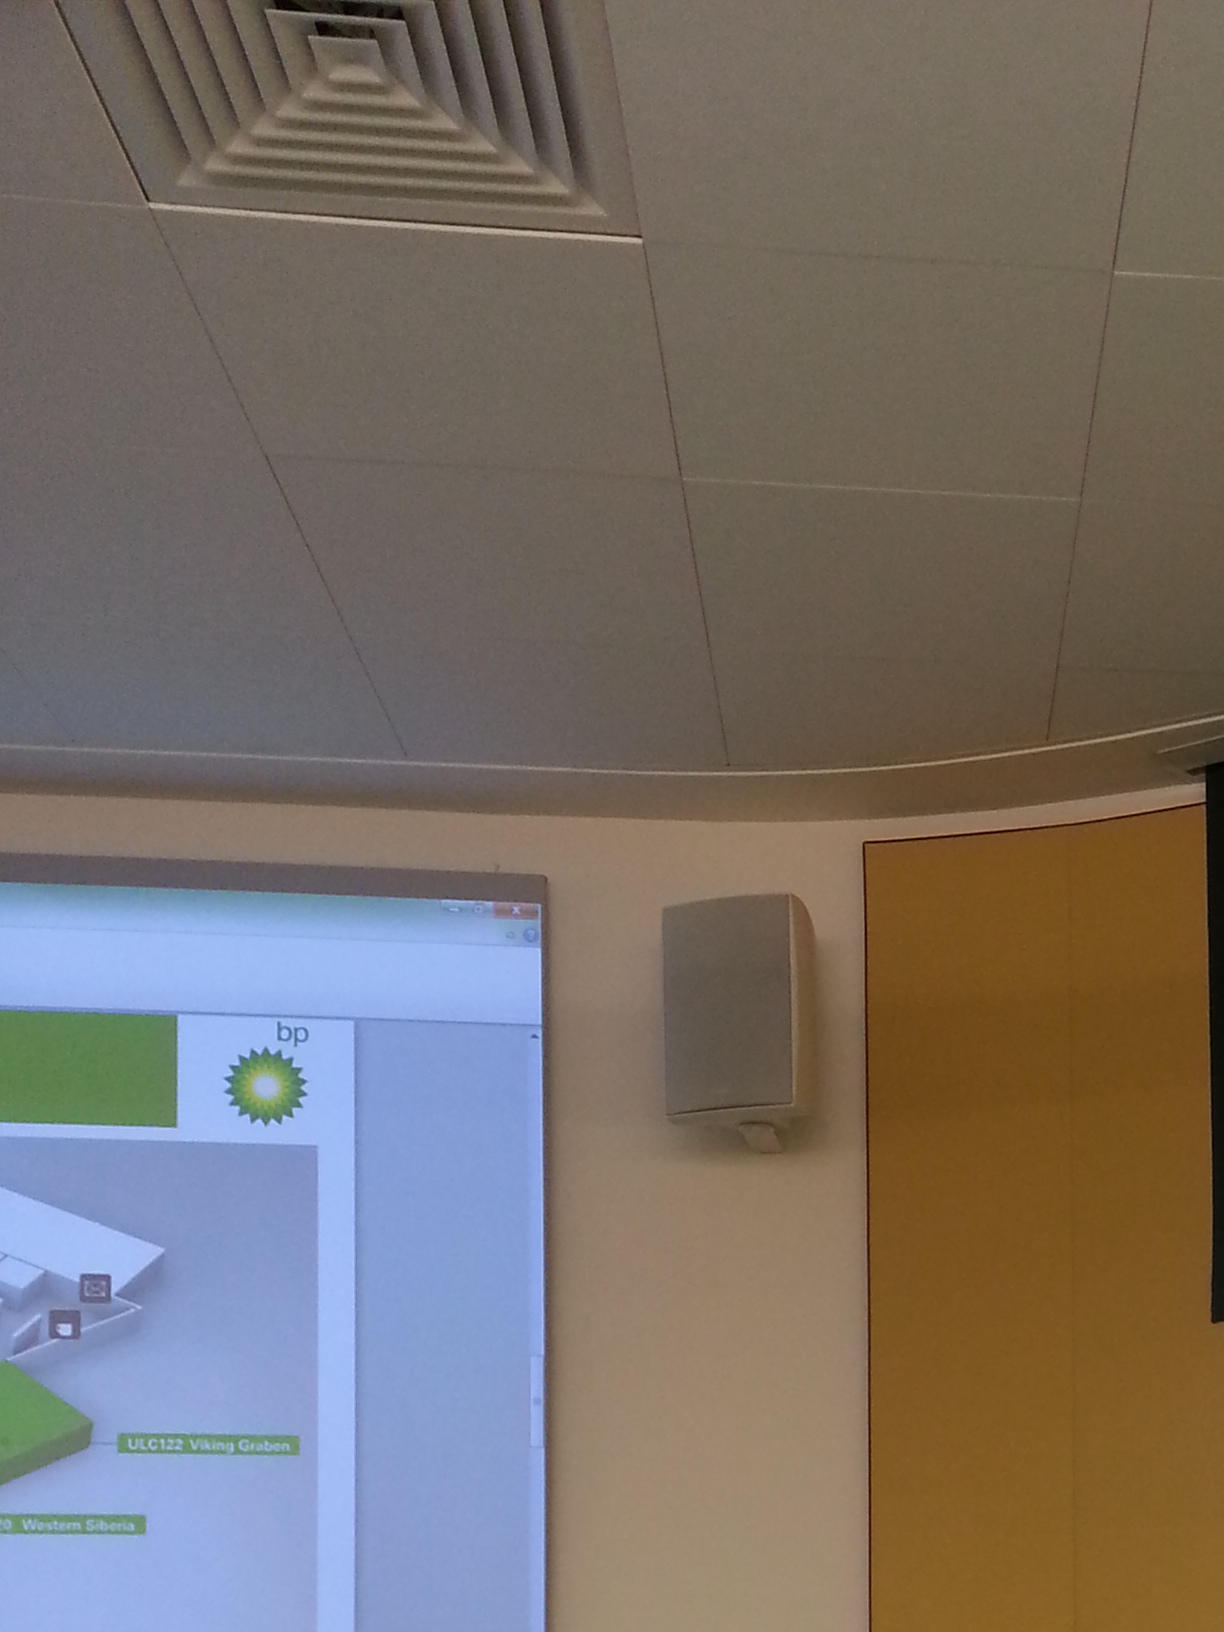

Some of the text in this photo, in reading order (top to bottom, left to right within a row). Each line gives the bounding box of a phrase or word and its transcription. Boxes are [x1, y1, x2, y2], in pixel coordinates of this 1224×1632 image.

[277, 1020, 309, 1047] bp
[189, 1438, 234, 1453] Viking
[238, 1439, 291, 1452] Graben
[22, 1519, 82, 1531] Western
